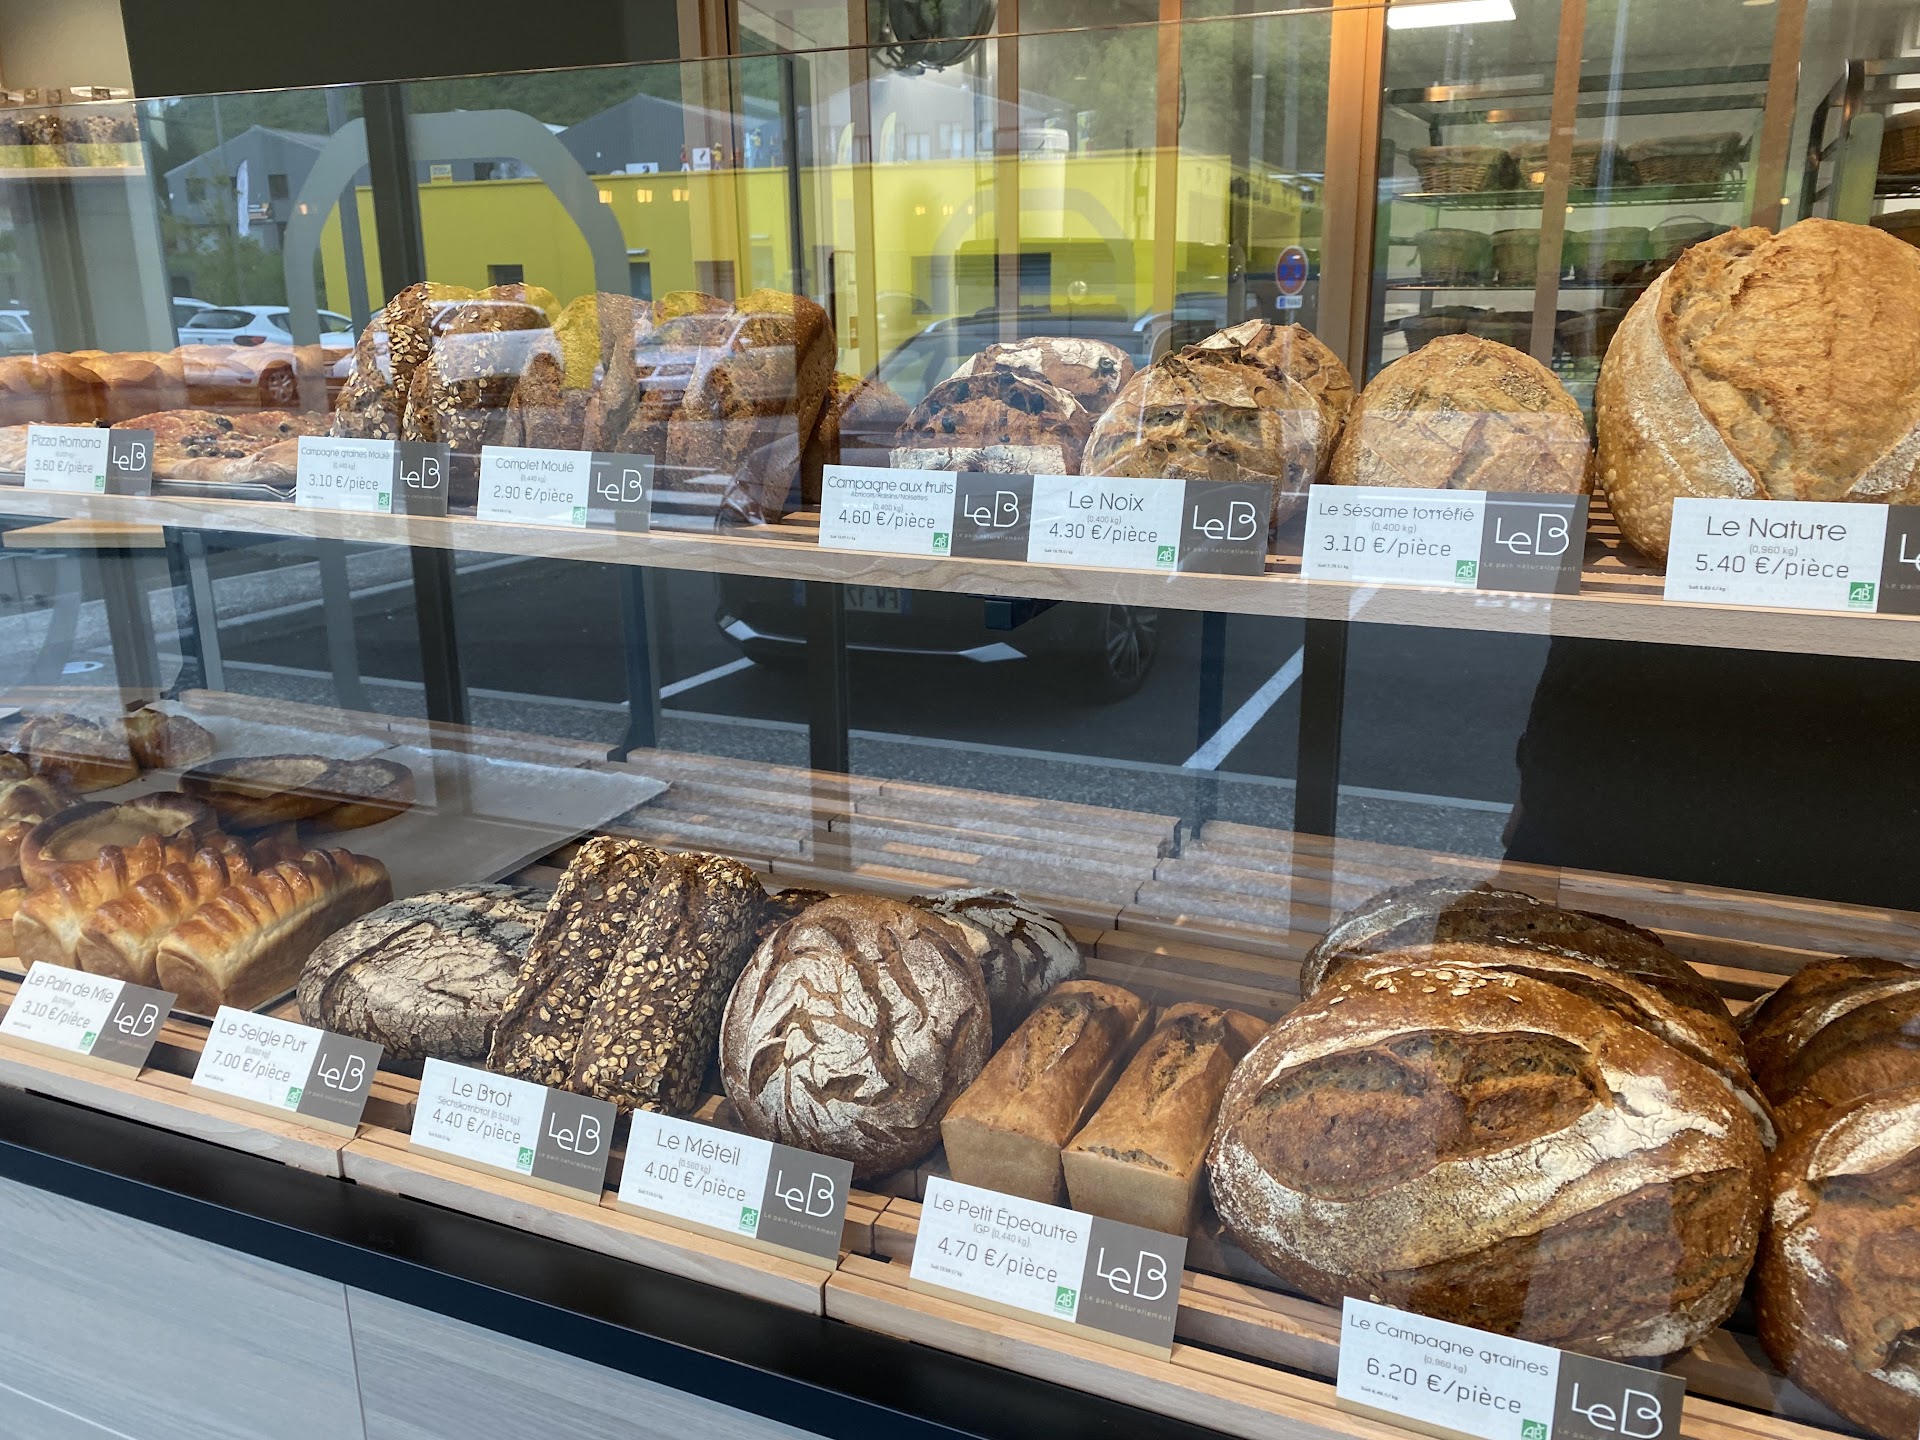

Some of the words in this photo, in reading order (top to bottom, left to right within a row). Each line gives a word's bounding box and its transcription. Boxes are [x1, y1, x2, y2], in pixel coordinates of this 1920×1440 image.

[32, 435, 57, 447] Pizza
[59, 436, 101, 449] Romana
[301, 447, 339, 457] Campagne
[341, 450, 367, 459] graines
[34, 459, 54, 471] 3.60
[58, 460, 93, 475] €/pièce
[496, 458, 539, 470] Complet
[542, 461, 574, 472] Moulé
[309, 474, 332, 487] 3.10
[336, 476, 378, 491] €/pièce
[828, 476, 897, 493] Campagne
[900, 480, 922, 491] aux
[925, 481, 953, 494] fruits
[494, 485, 520, 499] 2.90
[525, 487, 573, 503] €/pièce
[1069, 491, 1093, 509] Le
[1100, 493, 1144, 511] Noix
[839, 509, 870, 525] 4.60
[876, 512, 935, 529] €/pièce
[1320, 503, 1338, 515] Le
[1343, 504, 1408, 518] Sésame
[1413, 507, 1474, 521] torréfié
[1049, 523, 1084, 539] 4.30
[1092, 525, 1157, 544] €/pièce
[1403, 524, 1416, 534] kg)
[1707, 516, 1740, 536] Le
[1750, 518, 1847, 541] Nature
[1323, 535, 1365, 552] 3.10
[1373, 537, 1451, 557] €/pièce
[1782, 547, 1798, 557] kg)
[1696, 554, 1745, 573] 5.40
[1755, 557, 1849, 579] €/pièce
[28, 971, 45, 986] Le
[45, 976, 71, 993] Pain
[73, 983, 90, 996] de
[91, 986, 114, 1003] Mie
[22, 1000, 47, 1017] 3.10
[48, 1006, 91, 1028] €/pièce
[219, 1019, 237, 1035] Le
[239, 1023, 280, 1047] Seigle
[283, 1034, 308, 1052] Pur
[212, 1050, 240, 1069] 7.00
[242, 1058, 290, 1083] €/pièce
[452, 1077, 472, 1097] Le
[478, 1084, 513, 1108] Brot
[433, 1108, 462, 1129] 4.40
[467, 1118, 520, 1144] €/pièce
[657, 1129, 679, 1149] Le
[685, 1135, 740, 1166] Méteil
[644, 1162, 678, 1184] 4.00
[684, 1171, 745, 1201] €/pièce
[934, 1194, 954, 1211] Le
[958, 1200, 992, 1222] Petit
[997, 1208, 1077, 1243] Épeautre
[973, 1223, 990, 1234] IGP
[938, 1237, 977, 1262] 4.70
[984, 1249, 1057, 1283] €/pièce
[1351, 1314, 1370, 1330] Le
[1376, 1322, 1474, 1358] Campagne
[1479, 1349, 1549, 1377] graines
[1453, 1360, 1467, 1375] kg)
[1367, 1358, 1417, 1386] 6.20
[1427, 1374, 1522, 1414] €/pièce
